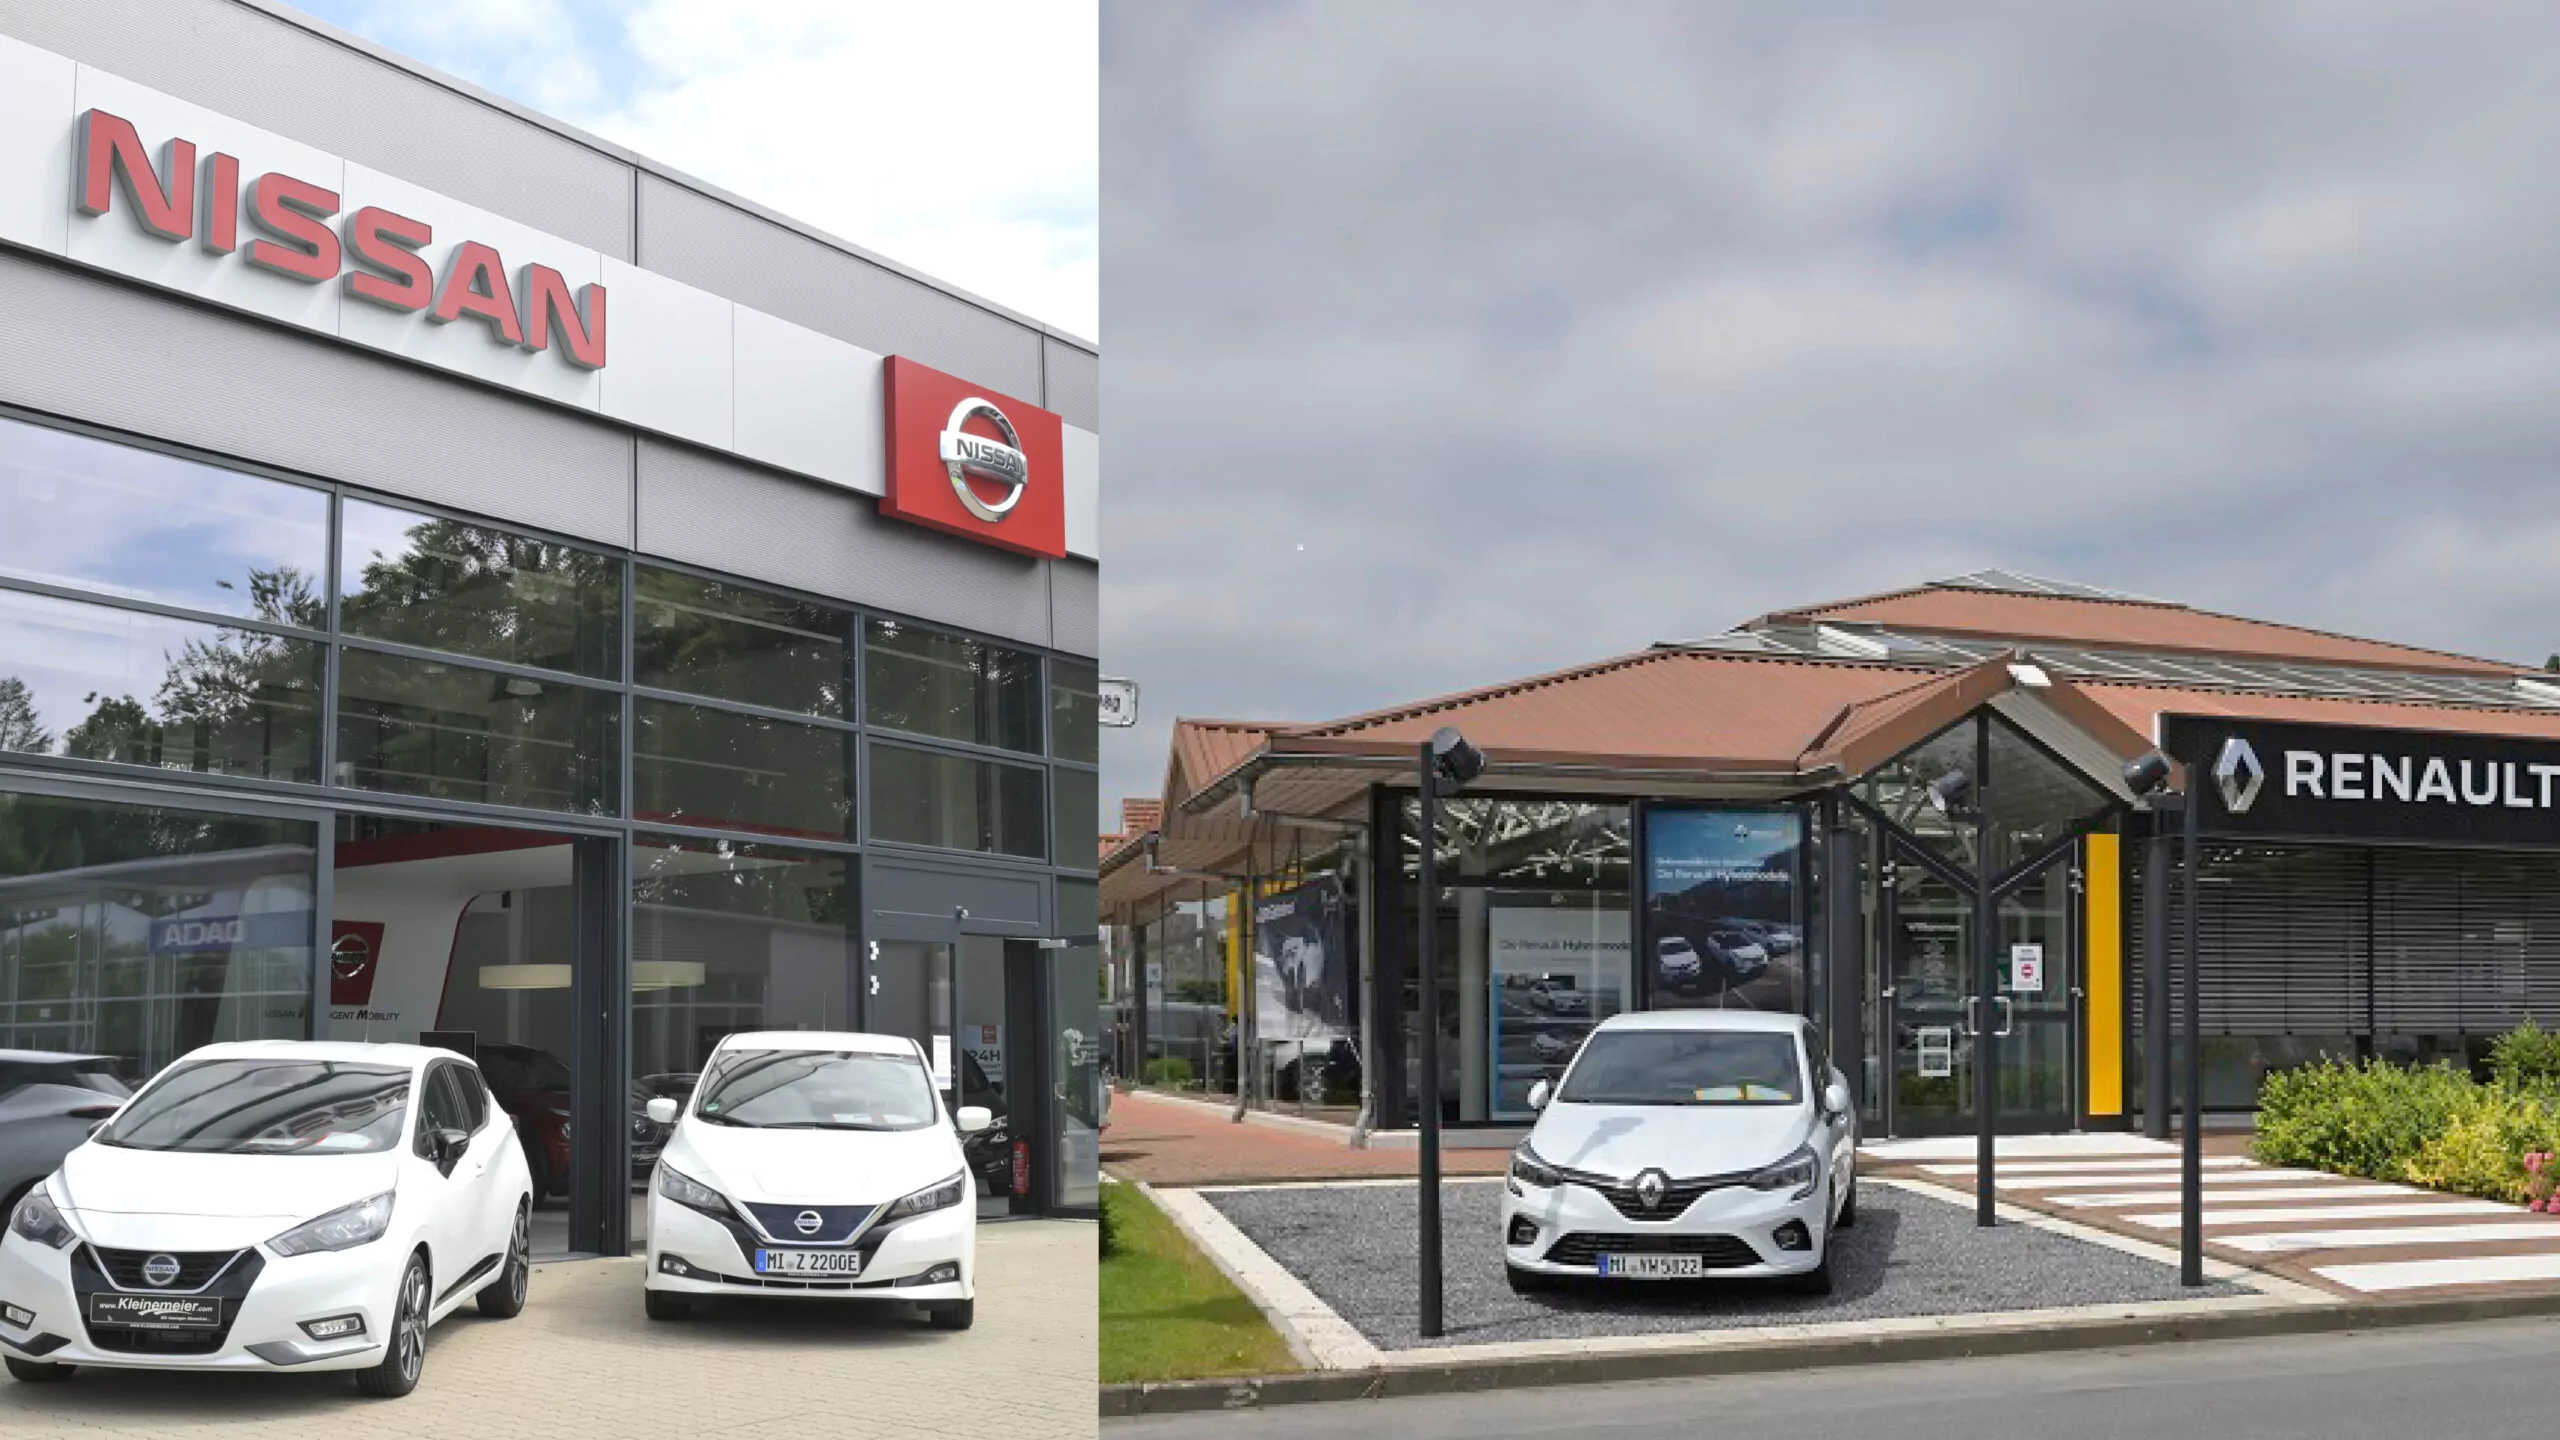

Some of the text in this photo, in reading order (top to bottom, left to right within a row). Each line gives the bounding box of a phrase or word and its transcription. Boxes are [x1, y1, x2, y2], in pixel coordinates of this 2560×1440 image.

[77, 108, 606, 371] NISSAN
[957, 438, 1027, 477] NISSAN
[2284, 751, 2560, 808] RENAULT
[766, 1253, 784, 1269] MI
[796, 1254, 805, 1270] Z
[810, 1254, 857, 1271] 2200E
[1610, 1259, 1626, 1272] MI
[99, 1297, 213, 1313] www.Kleinemeier.com
